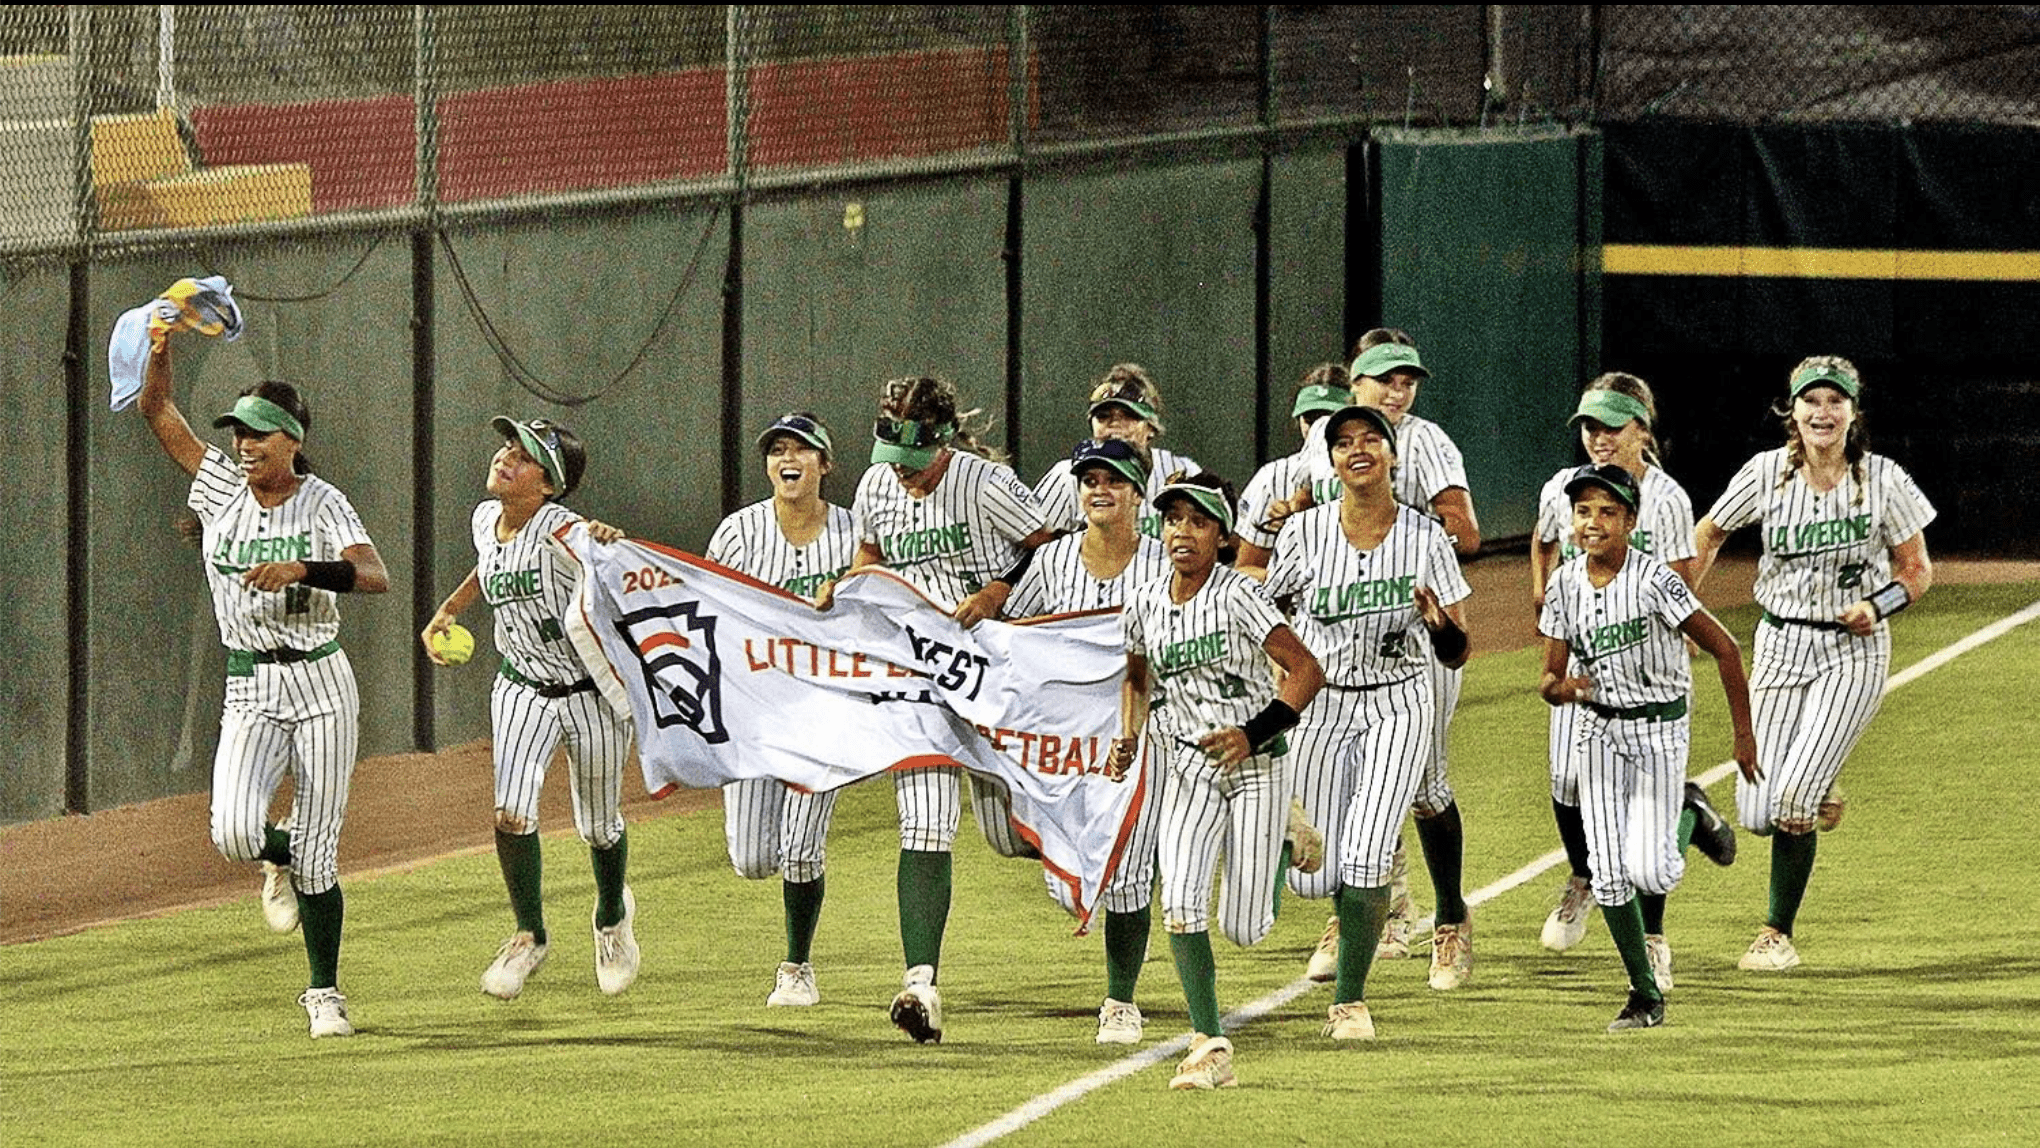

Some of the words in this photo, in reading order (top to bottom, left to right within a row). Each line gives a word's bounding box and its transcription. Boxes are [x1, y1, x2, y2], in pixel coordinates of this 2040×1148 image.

[237, 531, 312, 565] VERNE
[897, 522, 972, 560] VERNE
[1767, 526, 1789, 552] LA
[1795, 512, 1873, 551] VERNE
[1309, 586, 1330, 616] LA
[1337, 574, 1417, 612] VERNE
[1161, 629, 1229, 672] VERNE
[1588, 617, 1650, 657] VERNE
[744, 637, 873, 678] LITTLE
[966, 709, 1135, 778] FTBAL
